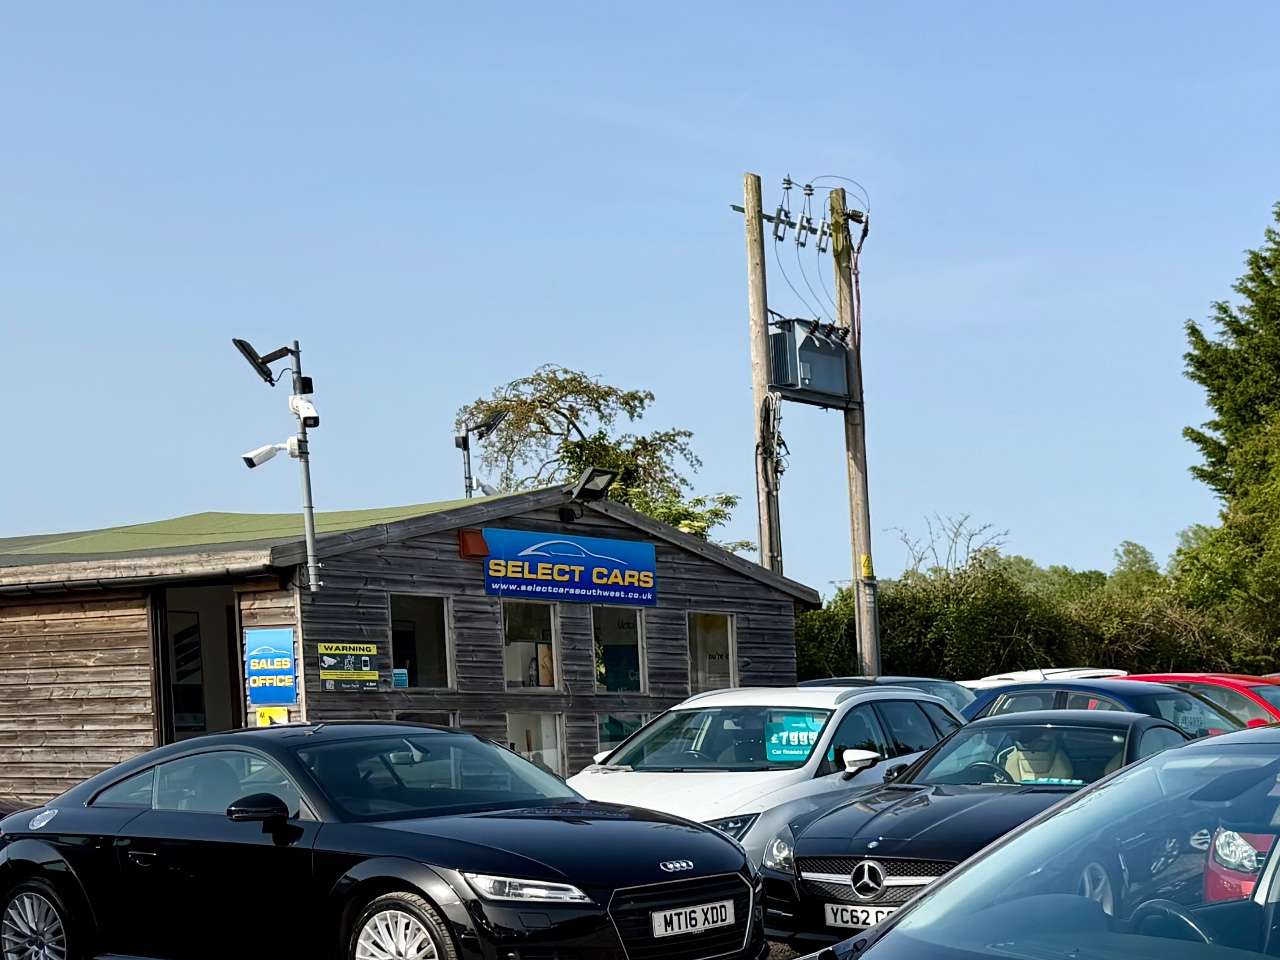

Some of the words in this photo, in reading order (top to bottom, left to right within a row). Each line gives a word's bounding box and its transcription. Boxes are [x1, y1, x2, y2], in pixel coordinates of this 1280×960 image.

[488, 559, 584, 582] SELECT
[592, 567, 654, 588] CARS
[323, 645, 372, 653] WARNING
[250, 657, 291, 670] SALES
[249, 675, 294, 688] OFFICE
[663, 911, 698, 933] MT16
[702, 904, 728, 927] XDD
[830, 907, 871, 926] YC62
